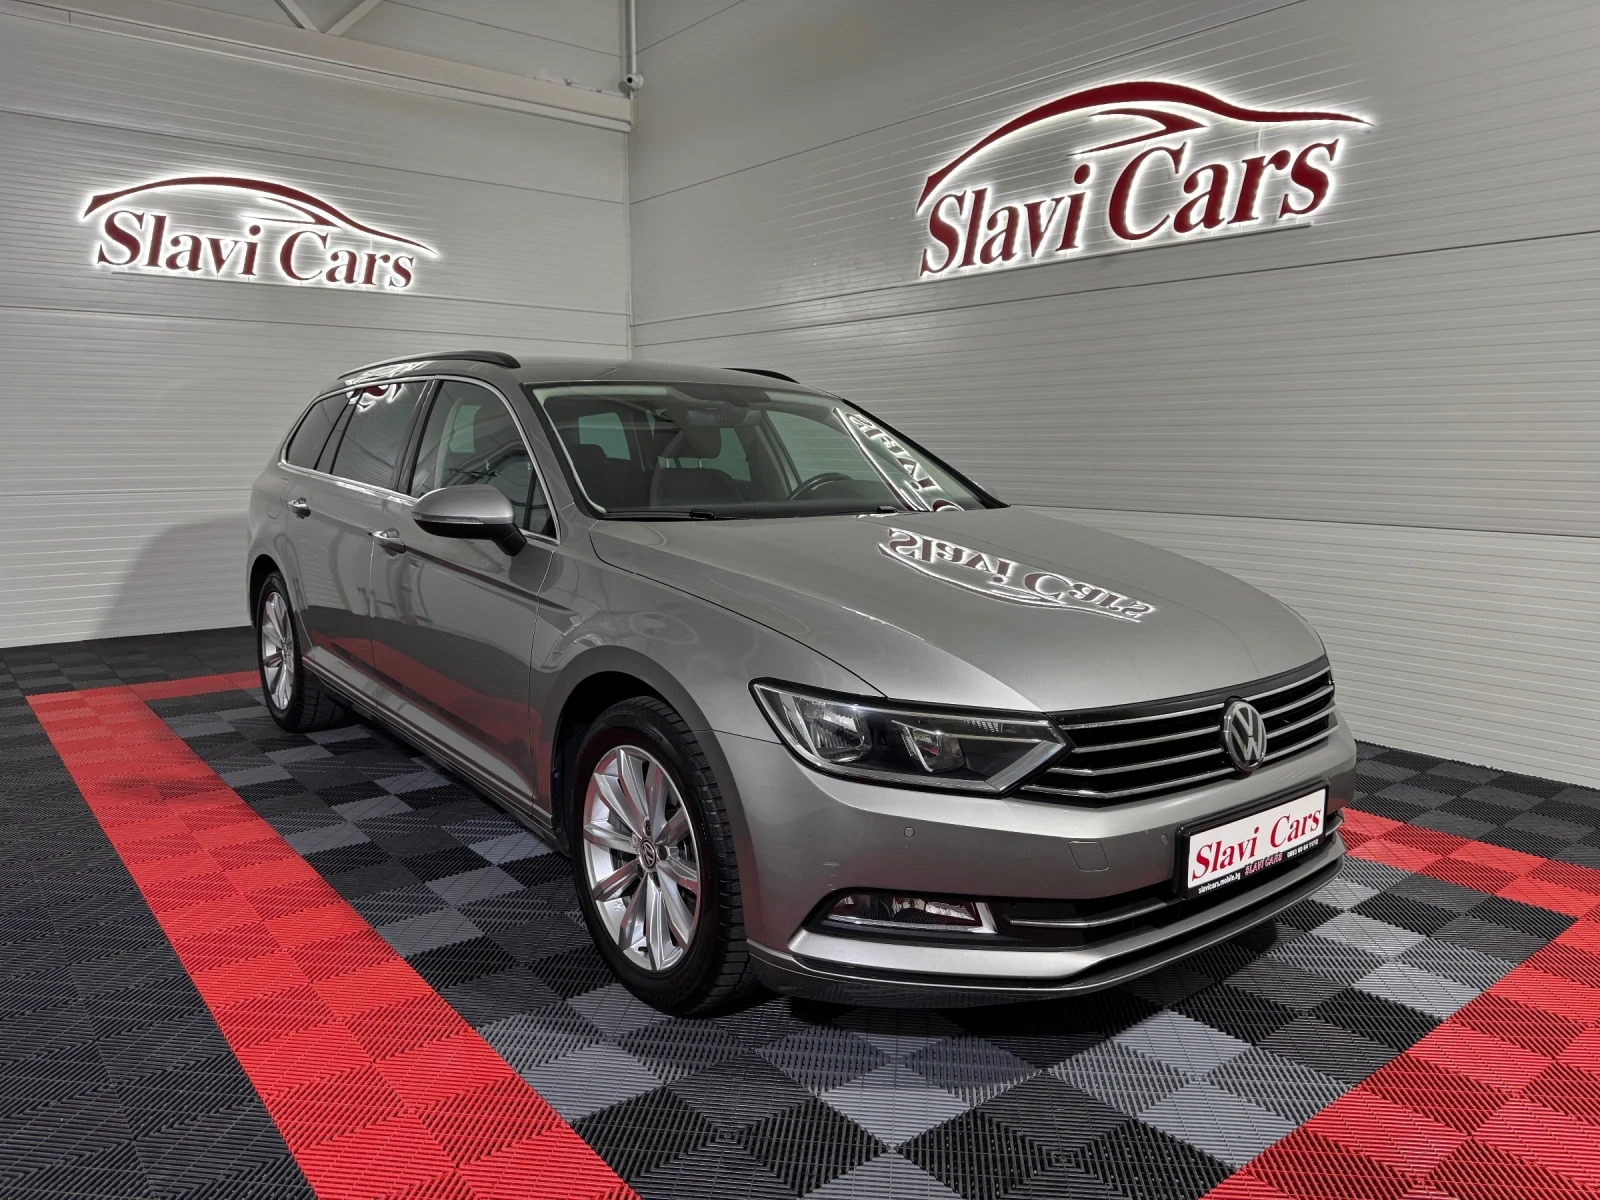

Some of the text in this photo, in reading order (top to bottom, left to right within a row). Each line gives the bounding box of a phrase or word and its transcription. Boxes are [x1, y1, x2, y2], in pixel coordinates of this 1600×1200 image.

[919, 138, 1340, 277] Slavi Cars
[97, 209, 415, 288] Slavi Cars
[1191, 809, 1322, 882] Slavi Cars
[1244, 852, 1283, 876] SLAVI CARS
[1198, 872, 1241, 895] slavicars.mobile.bg
